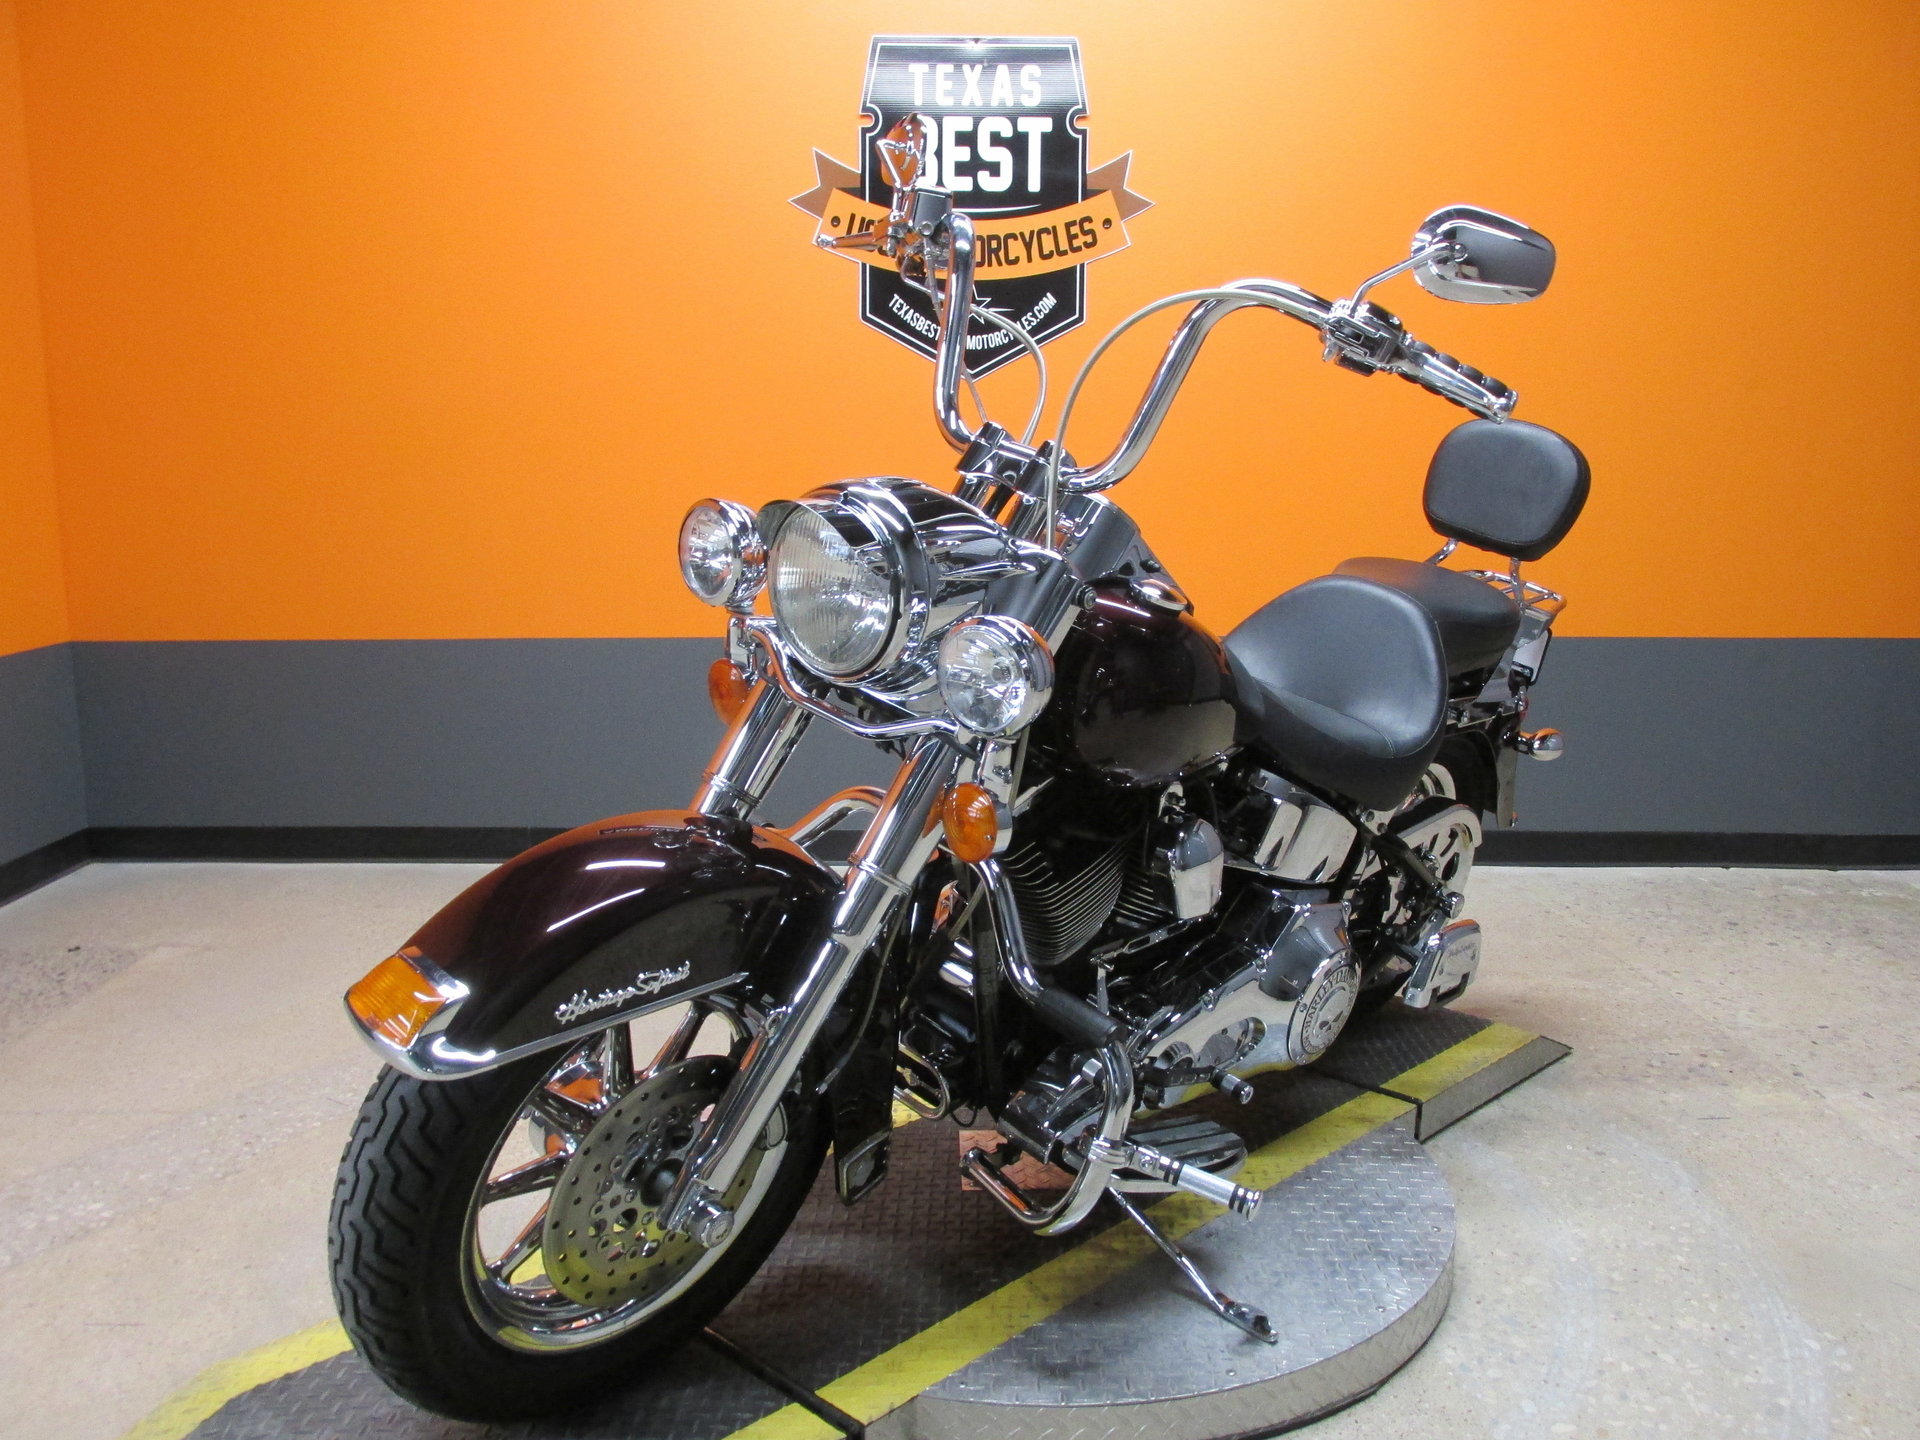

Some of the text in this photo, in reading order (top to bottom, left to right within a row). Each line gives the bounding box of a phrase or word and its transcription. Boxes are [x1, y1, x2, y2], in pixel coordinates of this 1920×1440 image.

[908, 64, 1042, 107] TEXAS
[914, 115, 1053, 193] BEST
[975, 215, 1098, 268] ORCYCLES
